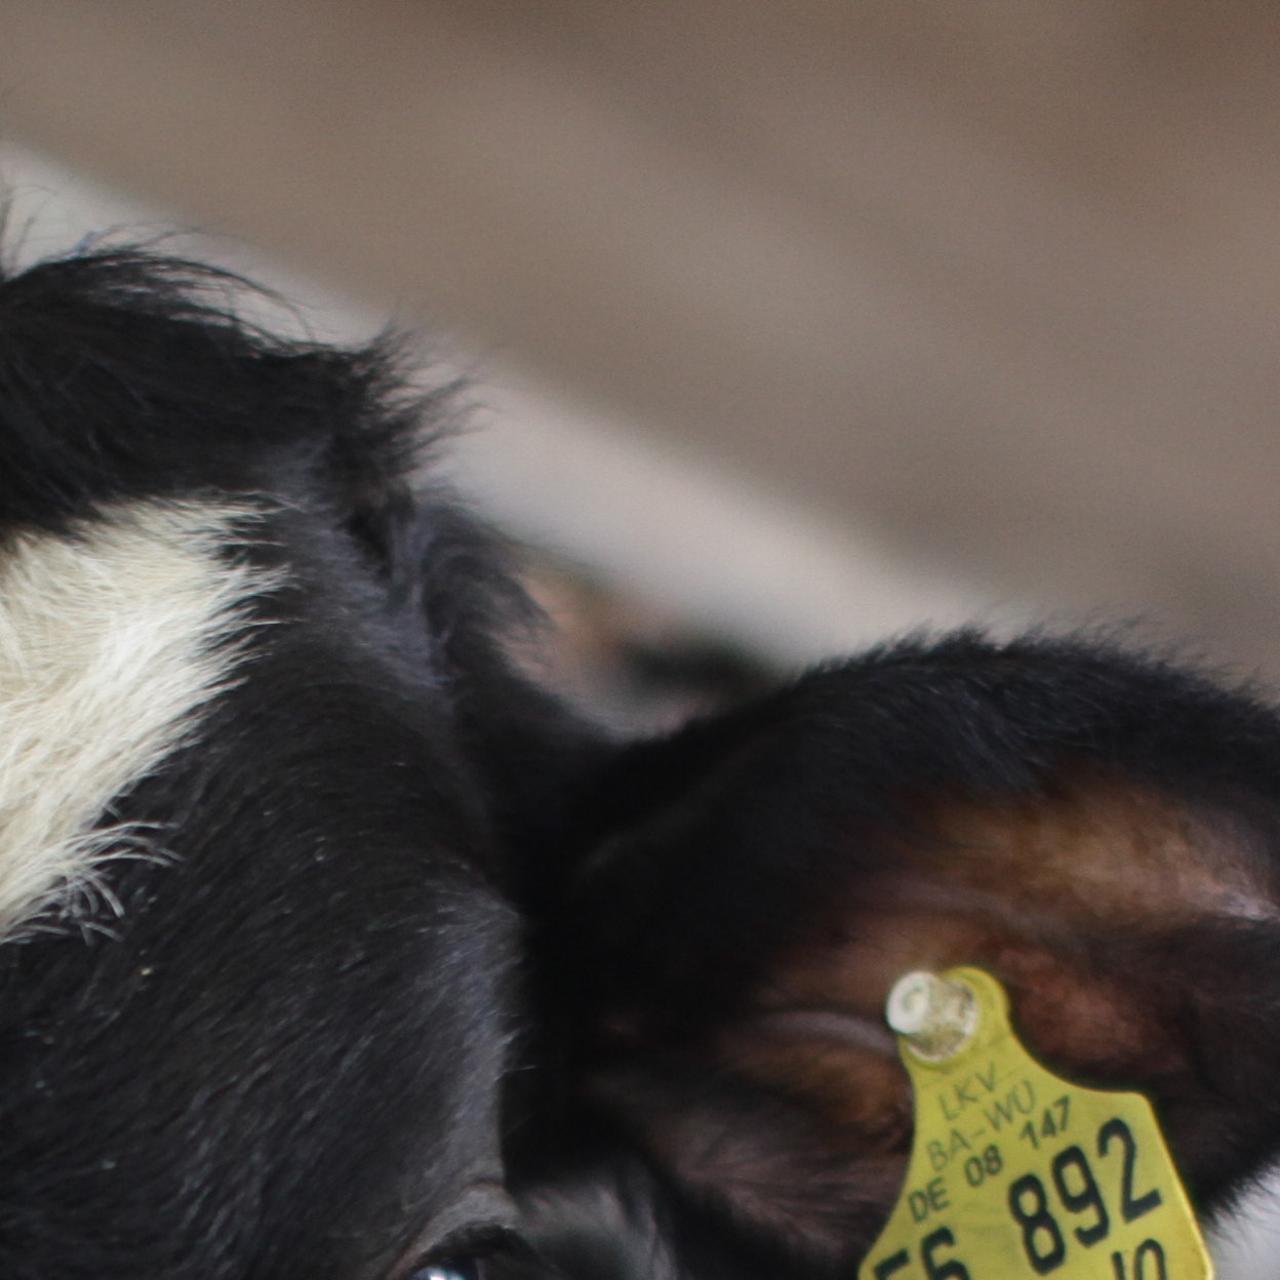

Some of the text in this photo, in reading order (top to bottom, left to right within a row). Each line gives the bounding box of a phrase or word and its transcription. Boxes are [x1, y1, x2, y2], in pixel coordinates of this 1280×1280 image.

[937, 1061, 996, 1121] LKV
[907, 1094, 1072, 1223] DE 08 147
[1007, 1117, 1163, 1277] 892
